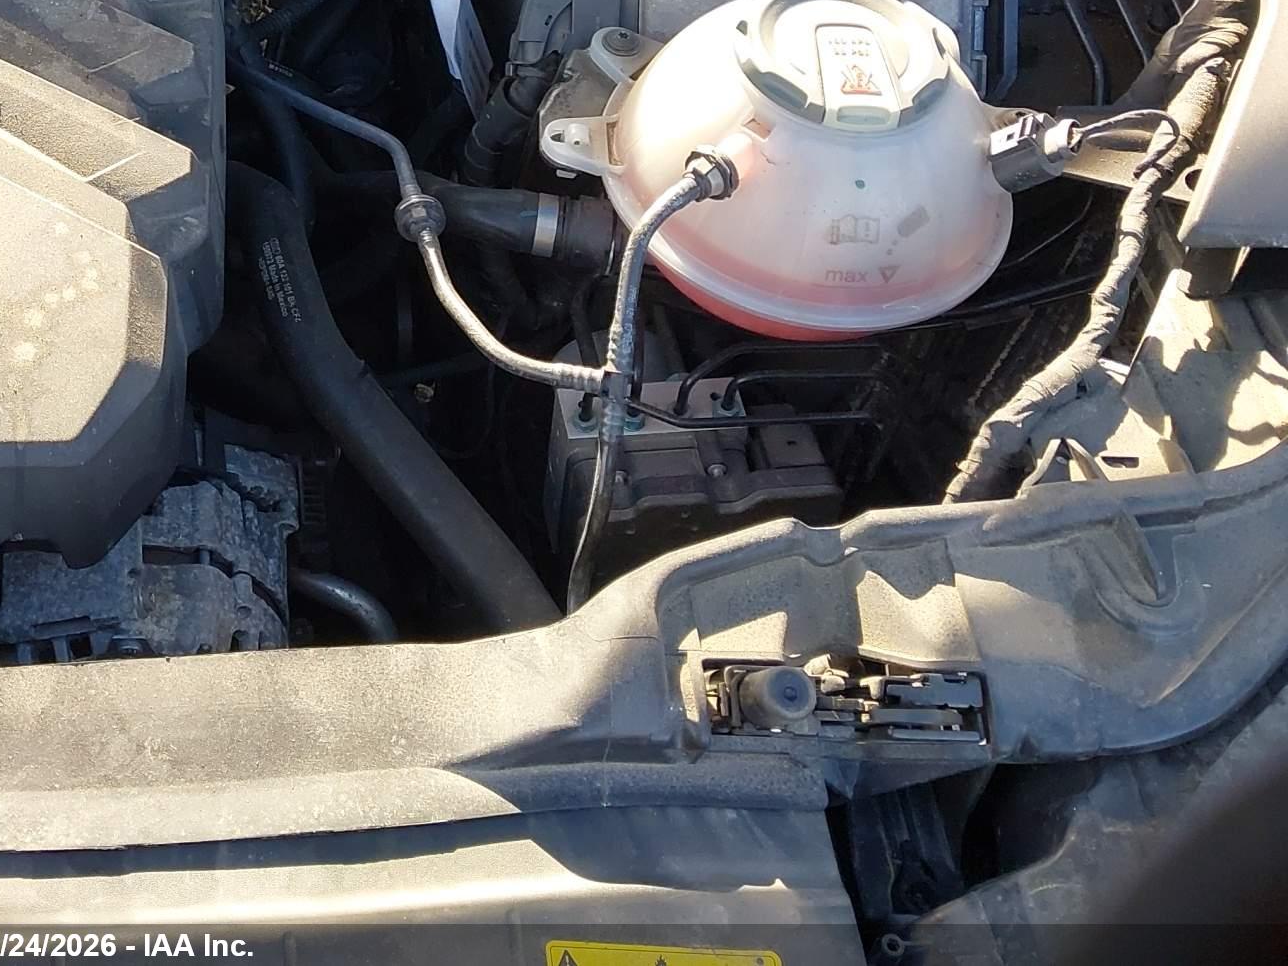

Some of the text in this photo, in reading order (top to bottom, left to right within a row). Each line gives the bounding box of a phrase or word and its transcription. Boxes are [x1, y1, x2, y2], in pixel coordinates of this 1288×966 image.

[268, 264, 279, 283] Made
[277, 291, 289, 317] Mexico
[825, 269, 868, 283] max
